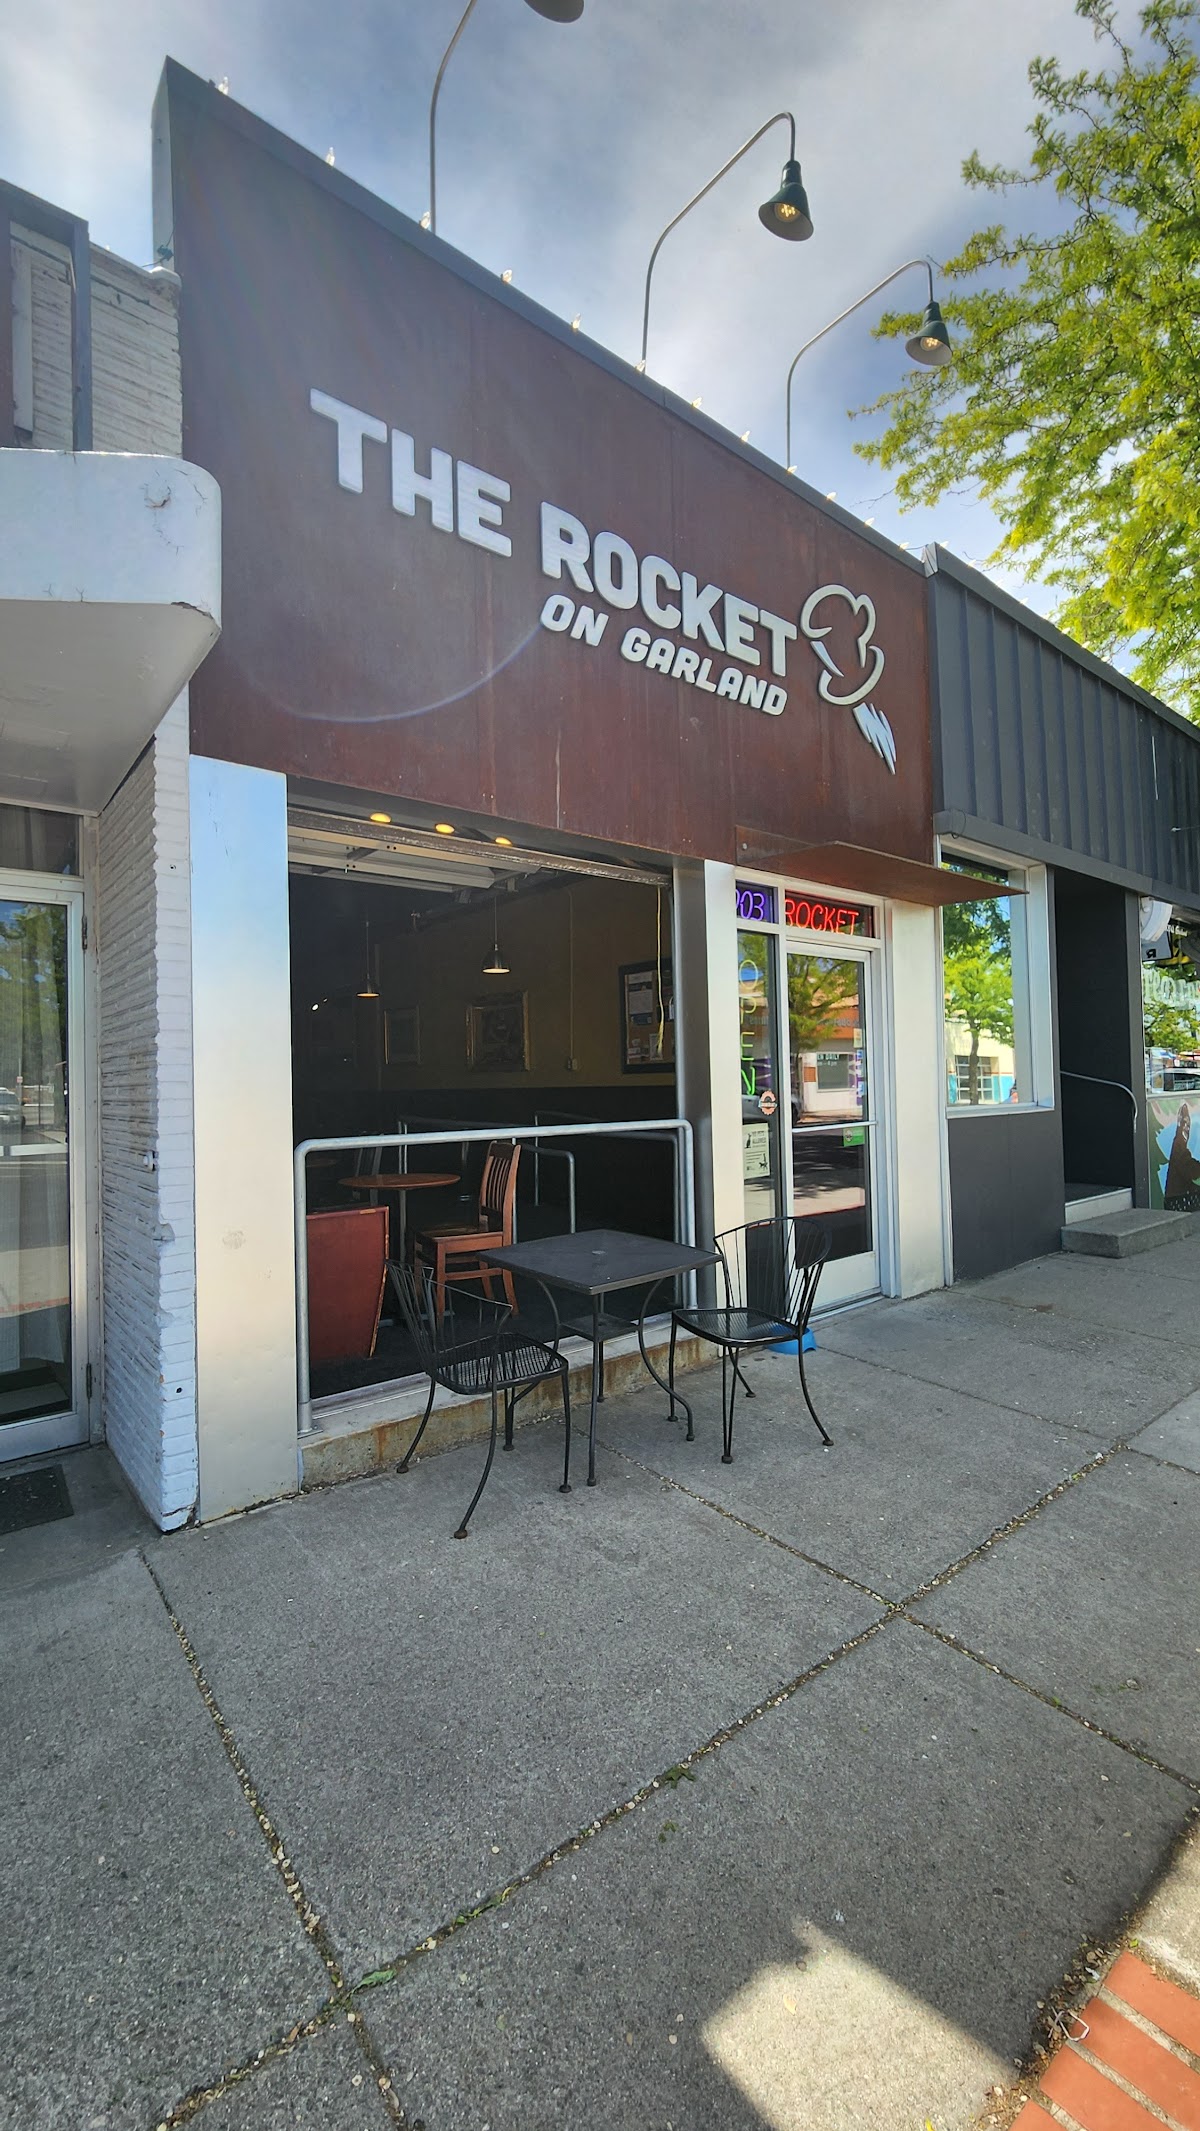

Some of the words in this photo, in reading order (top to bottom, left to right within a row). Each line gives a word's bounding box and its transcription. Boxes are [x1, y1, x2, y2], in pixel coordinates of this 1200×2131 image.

[310, 388, 513, 558] THE
[541, 501, 798, 678] ROCKET
[540, 594, 609, 646] ON
[620, 627, 788, 716] GARLAND
[784, 899, 860, 936] ROCKET
[740, 959, 757, 1096] OPEN
